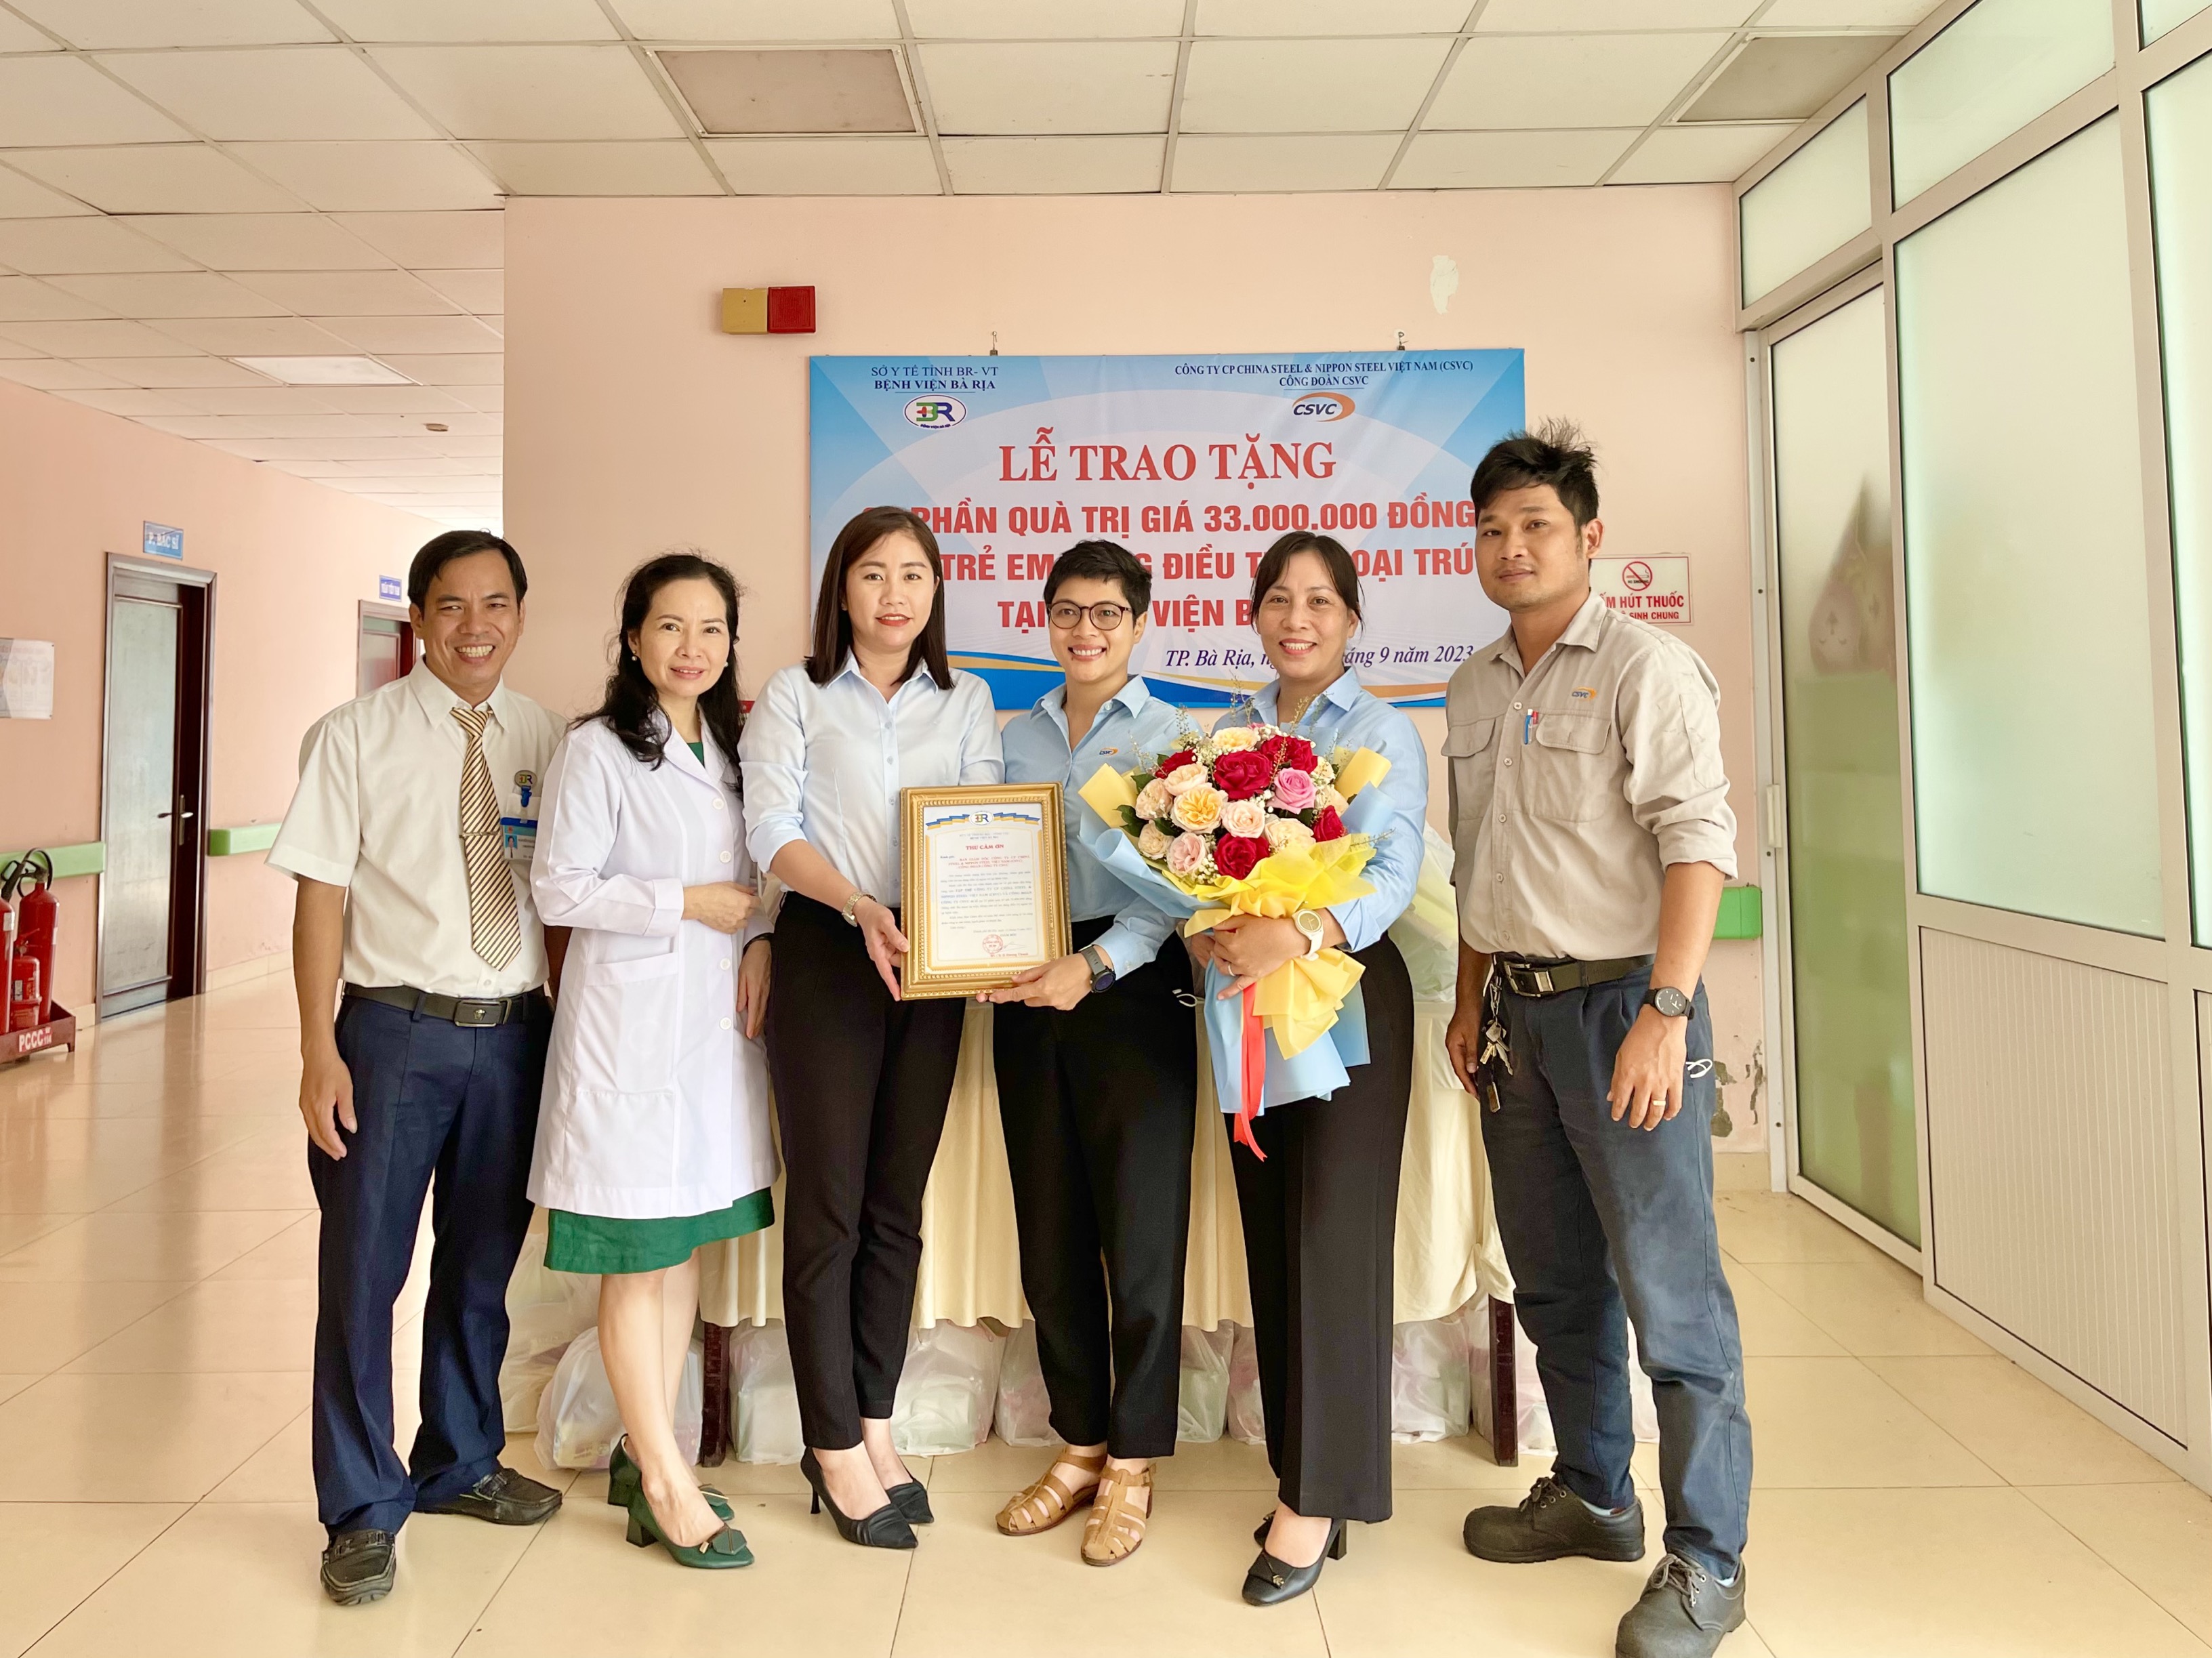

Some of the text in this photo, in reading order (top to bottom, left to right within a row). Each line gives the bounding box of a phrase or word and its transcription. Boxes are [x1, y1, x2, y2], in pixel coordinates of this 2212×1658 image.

[871, 365, 999, 376] SỞ Y TẾ TỈNH BR- VT
[1175, 360, 1473, 375] CÔNG TY CP CHINA STEEL & NIPPON STEEL VIỆT NAM (CSVC)
[874, 377, 996, 391] BỆNH VIỆN BÀ RỊA
[1279, 374, 1369, 386] CÔNG ĐOÀN CSVC
[1293, 403, 1337, 415] CSVC
[999, 427, 1336, 489] LỄ TRAO TẶNG
[1009, 501, 1071, 537] QUÀ
[1082, 506, 1130, 539] TRỊ
[1141, 499, 1193, 533] GIÁ
[1204, 502, 1377, 532] 33.000.000
[1387, 492, 1476, 529] ĐỒNG
[940, 545, 996, 581] TRẺ
[1008, 554, 1054, 581] EM
[1163, 543, 1235, 581] ĐIỀU
[1414, 542, 1473, 575] TRÚ
[1620, 593, 1642, 608] HÚT
[1646, 591, 1684, 608] THUỐC
[998, 600, 1045, 634] TẠI
[1151, 594, 1224, 632] VIỆN
[1166, 650, 1189, 667] TP.
[1195, 649, 1218, 666] Bà
[1222, 649, 1255, 669] Rịa,
[1378, 646, 1389, 663] 9
[1393, 646, 1429, 663] năm
[1434, 646, 1474, 662] 2023
[19, 1029, 43, 1052] PCCC
